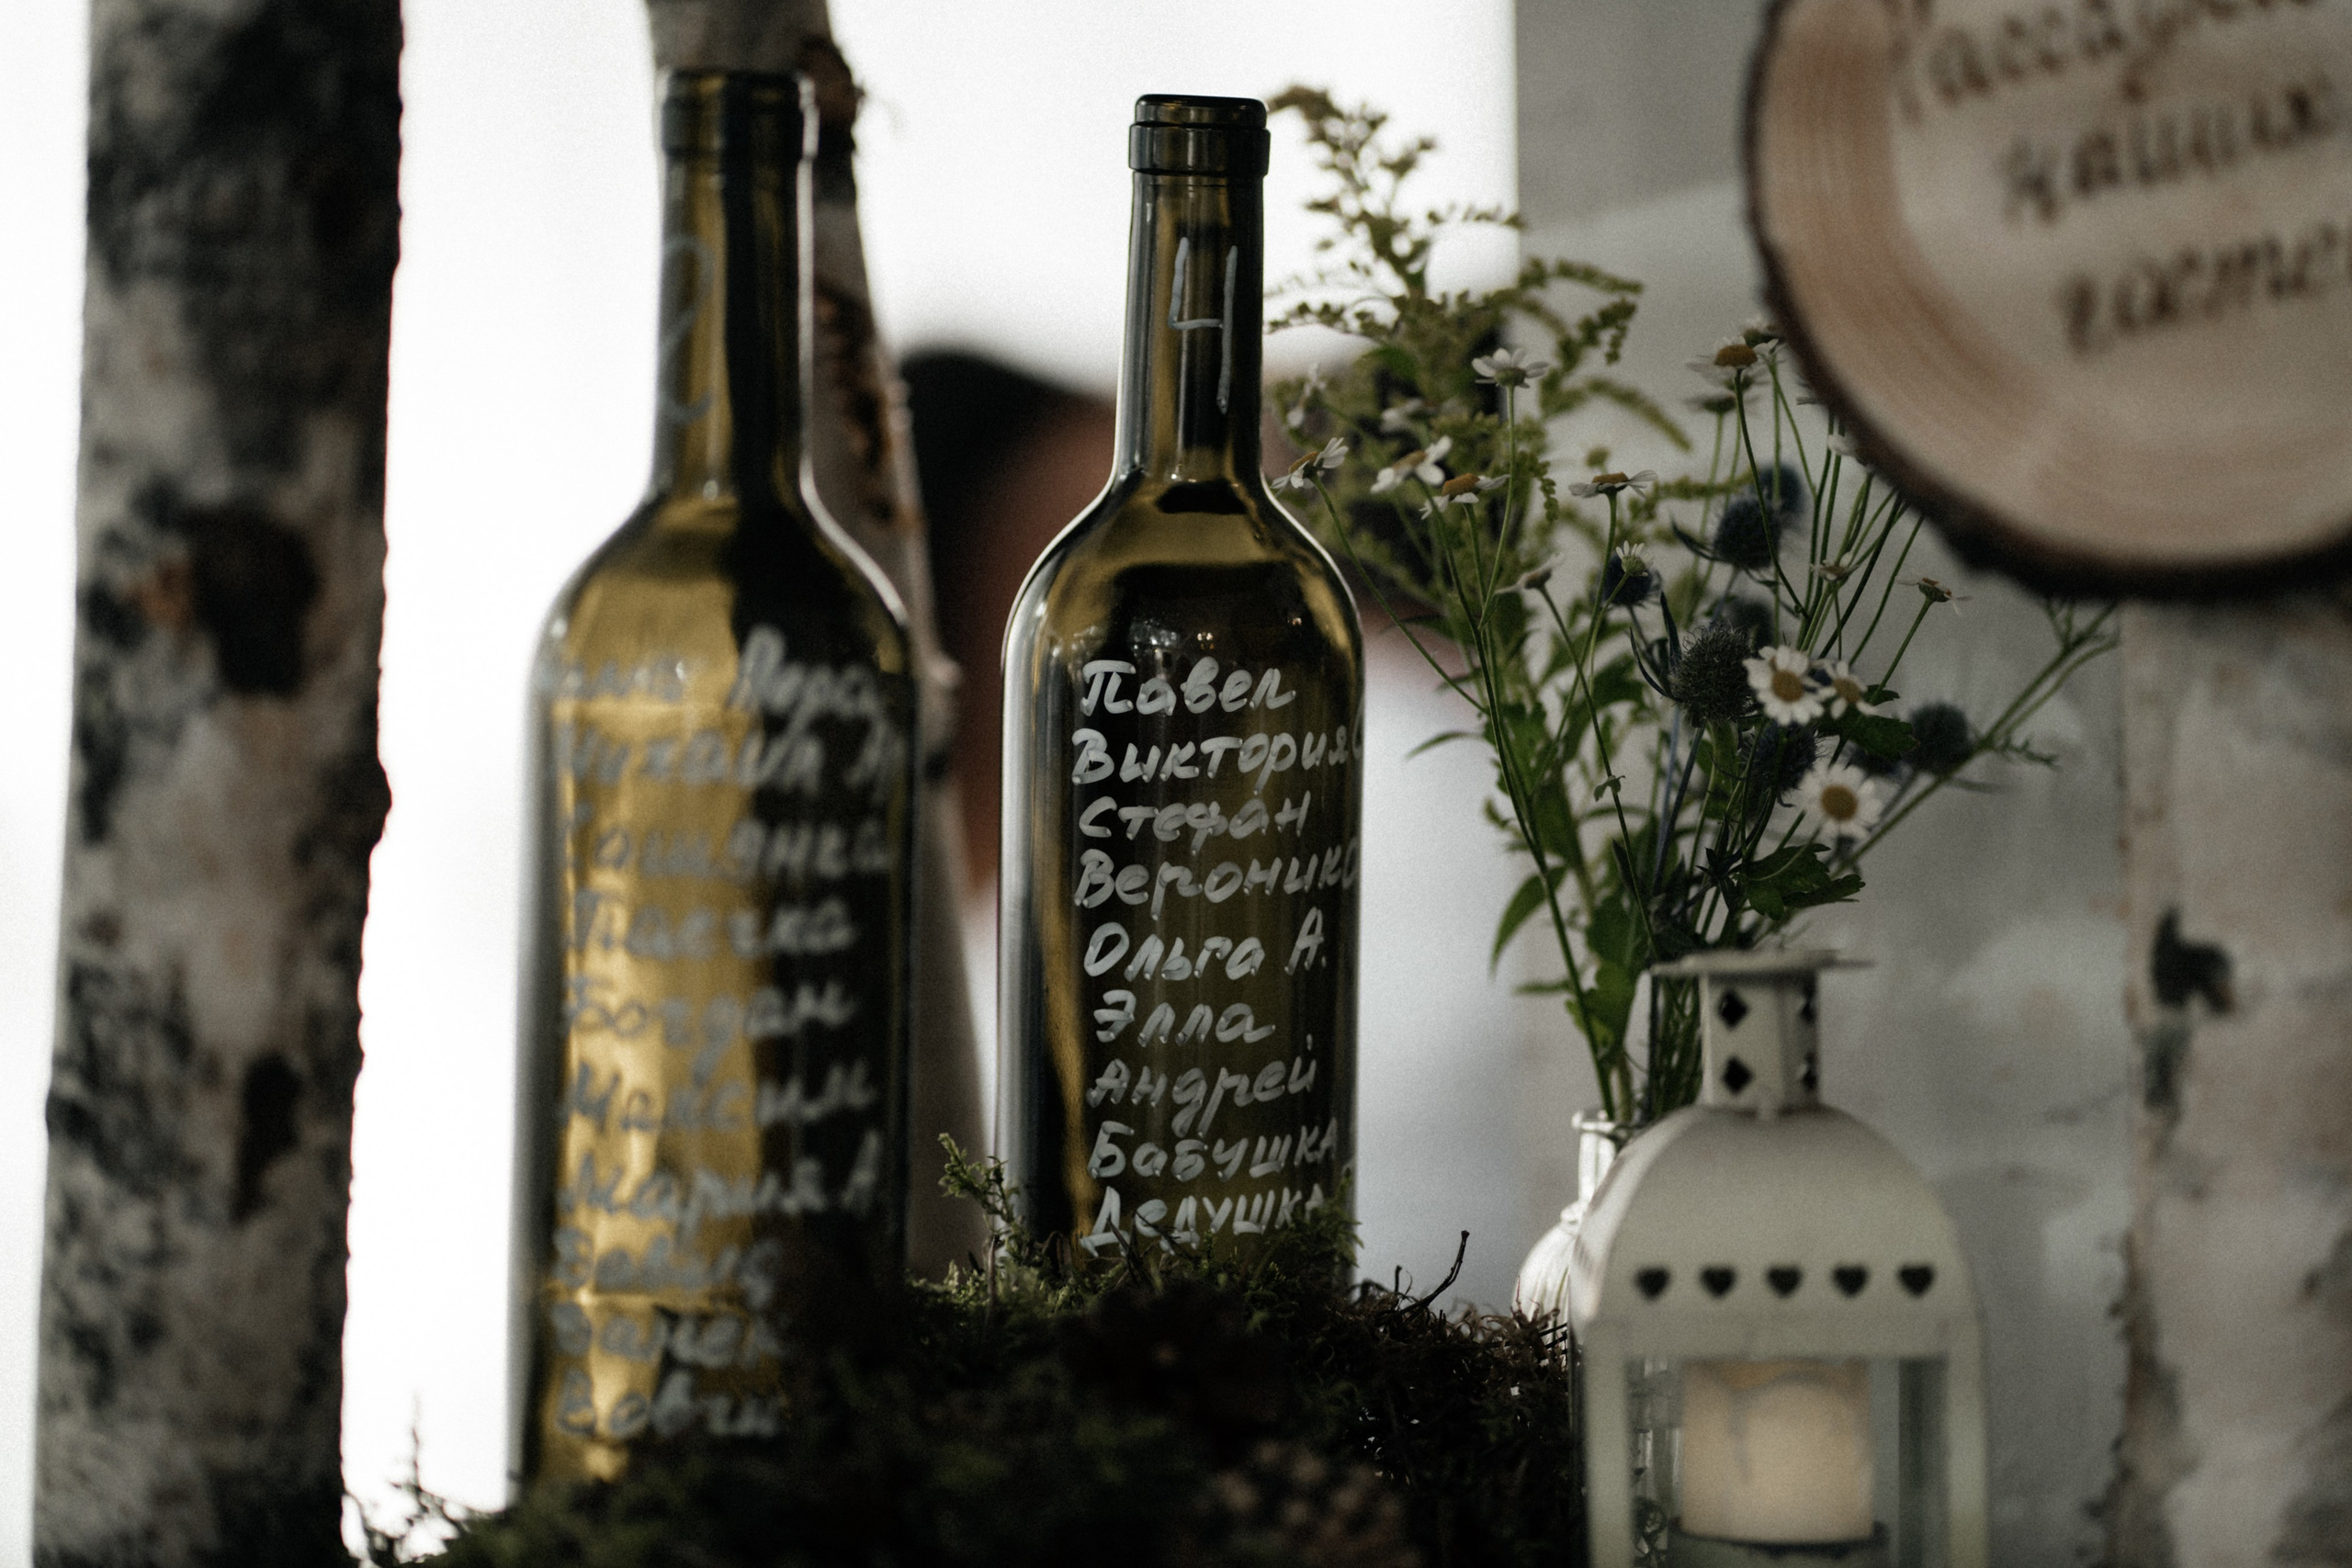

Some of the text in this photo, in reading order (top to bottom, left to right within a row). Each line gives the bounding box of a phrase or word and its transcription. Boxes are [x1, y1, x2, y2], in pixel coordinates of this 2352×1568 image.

[1167, 236, 1239, 415] 4
[2055, 220, 2352, 361] госте
[1080, 655, 1297, 717] Павел
[1070, 724, 1351, 795] Виктория
[1079, 789, 1312, 856] Стефан
[1073, 835, 1362, 921] Вероника
[1083, 920, 1266, 983] Ольга
[1092, 988, 1276, 1048] Элла
[1086, 1032, 1317, 1139] Андрей
[1087, 1116, 1338, 1183] Бабушка
[1079, 1185, 1324, 1258] Дедушка
